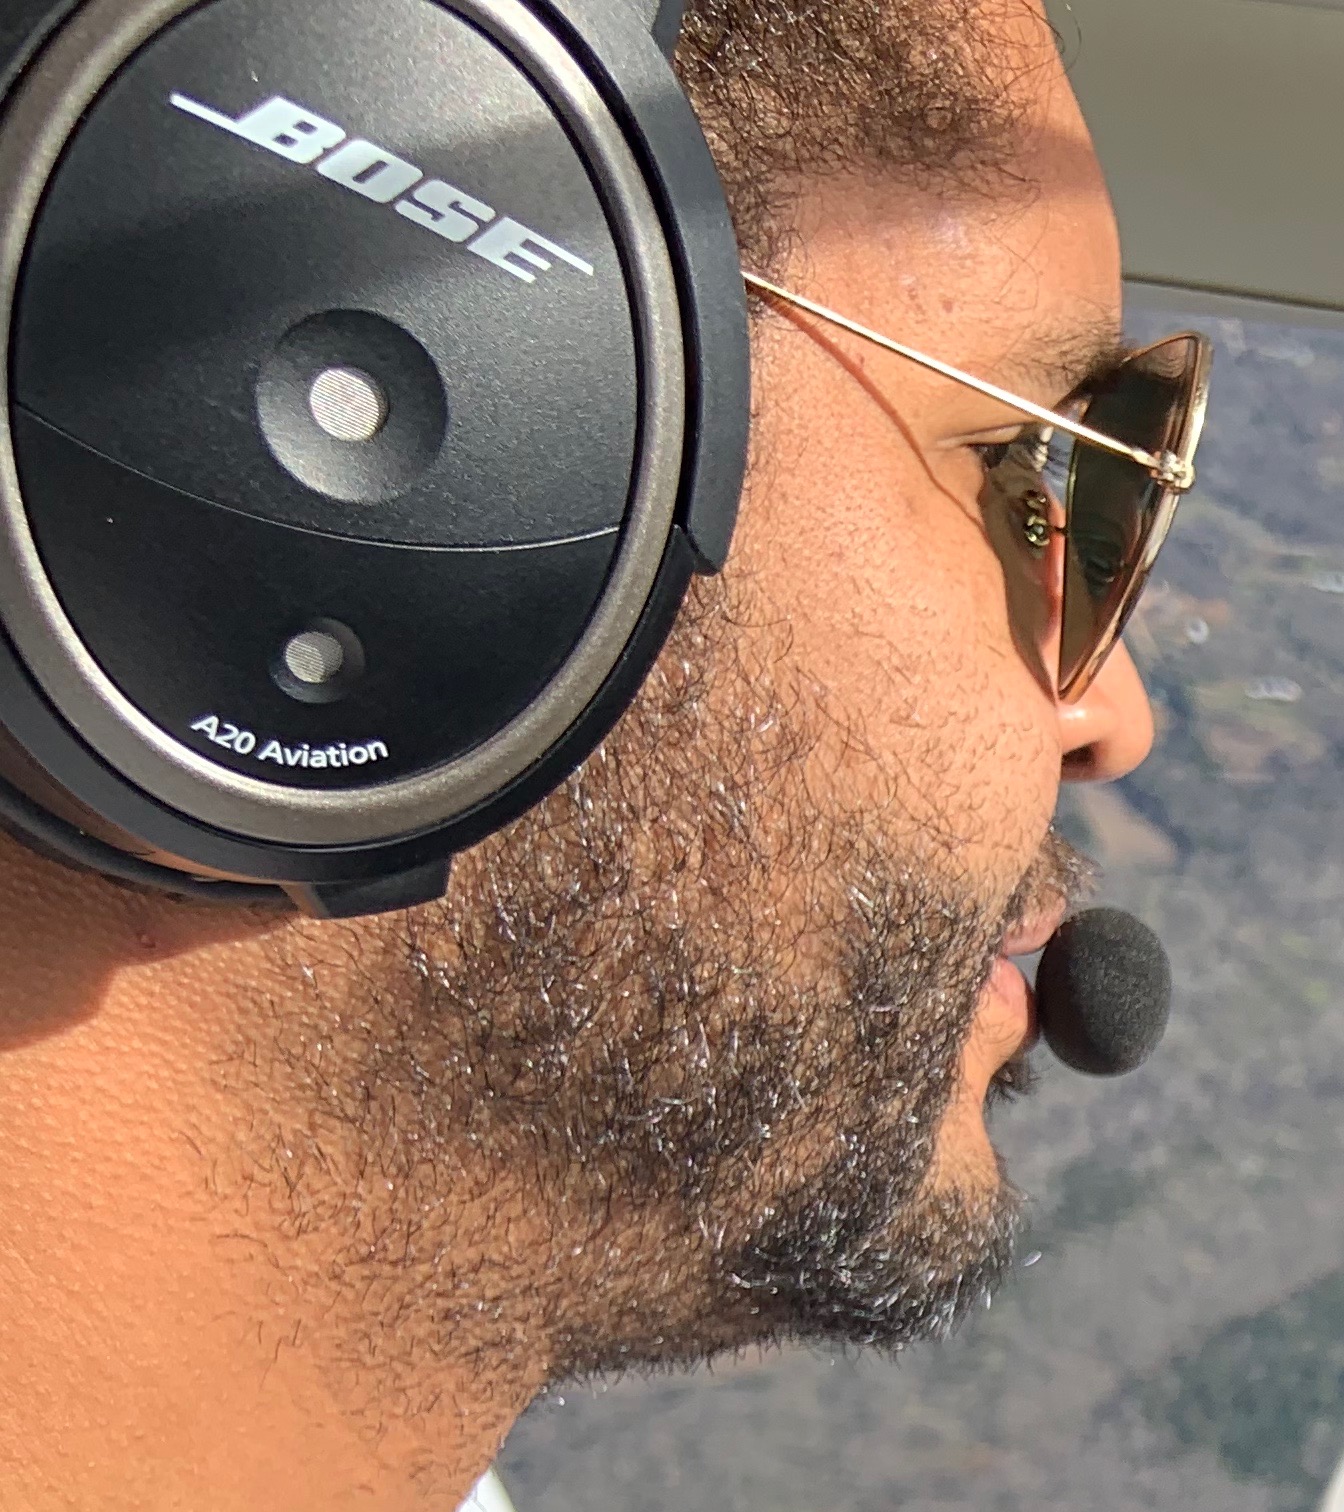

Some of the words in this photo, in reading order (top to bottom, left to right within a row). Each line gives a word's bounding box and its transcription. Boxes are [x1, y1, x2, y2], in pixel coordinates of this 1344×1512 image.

[168, 91, 595, 285] BOSE
[190, 711, 258, 761] A20
[257, 735, 390, 770] Aviation
